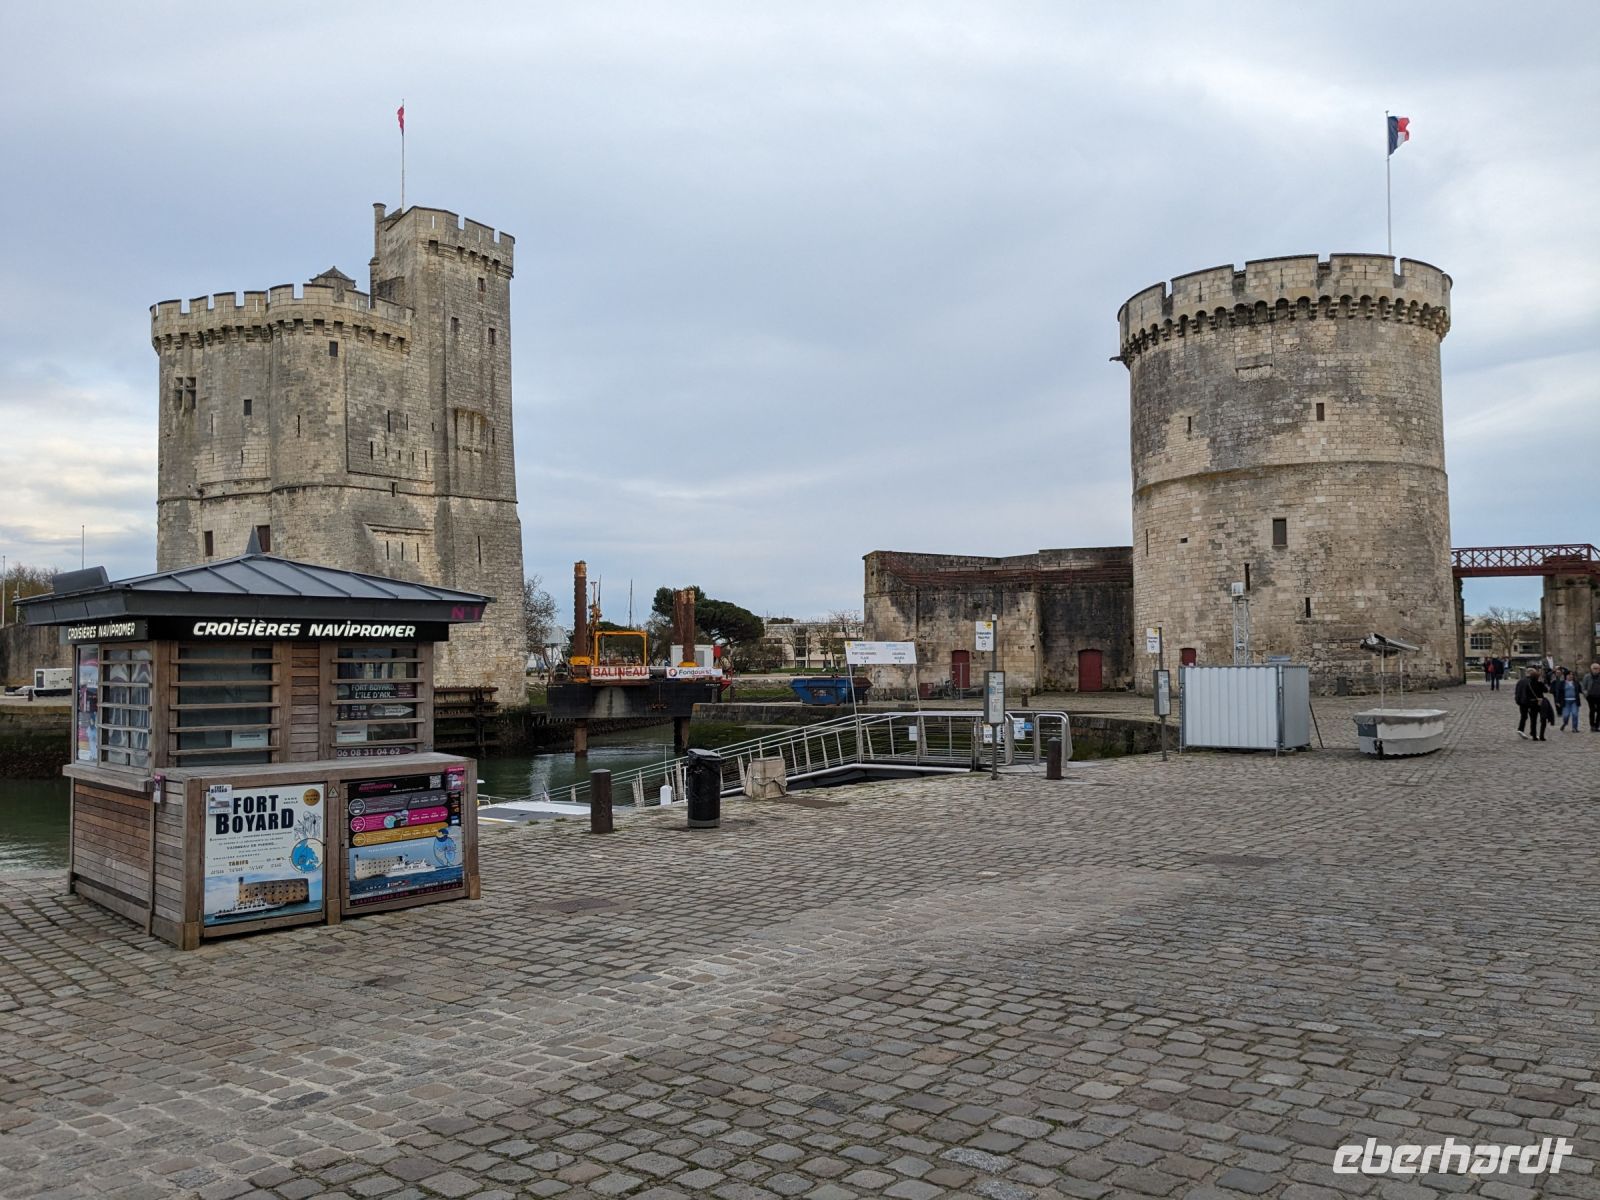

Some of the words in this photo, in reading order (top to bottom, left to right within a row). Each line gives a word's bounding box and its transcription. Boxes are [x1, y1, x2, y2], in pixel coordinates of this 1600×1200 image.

[308, 620, 416, 638] NAVIPROMER
[593, 667, 647, 677] BALINEAU
[337, 749, 348, 757] 06
[350, 749, 361, 757] 08
[364, 748, 374, 756] 31
[376, 748, 388, 756] 04
[389, 747, 401, 755] 62
[233, 795, 279, 814] FORT
[215, 808, 294, 835] BOYARD
